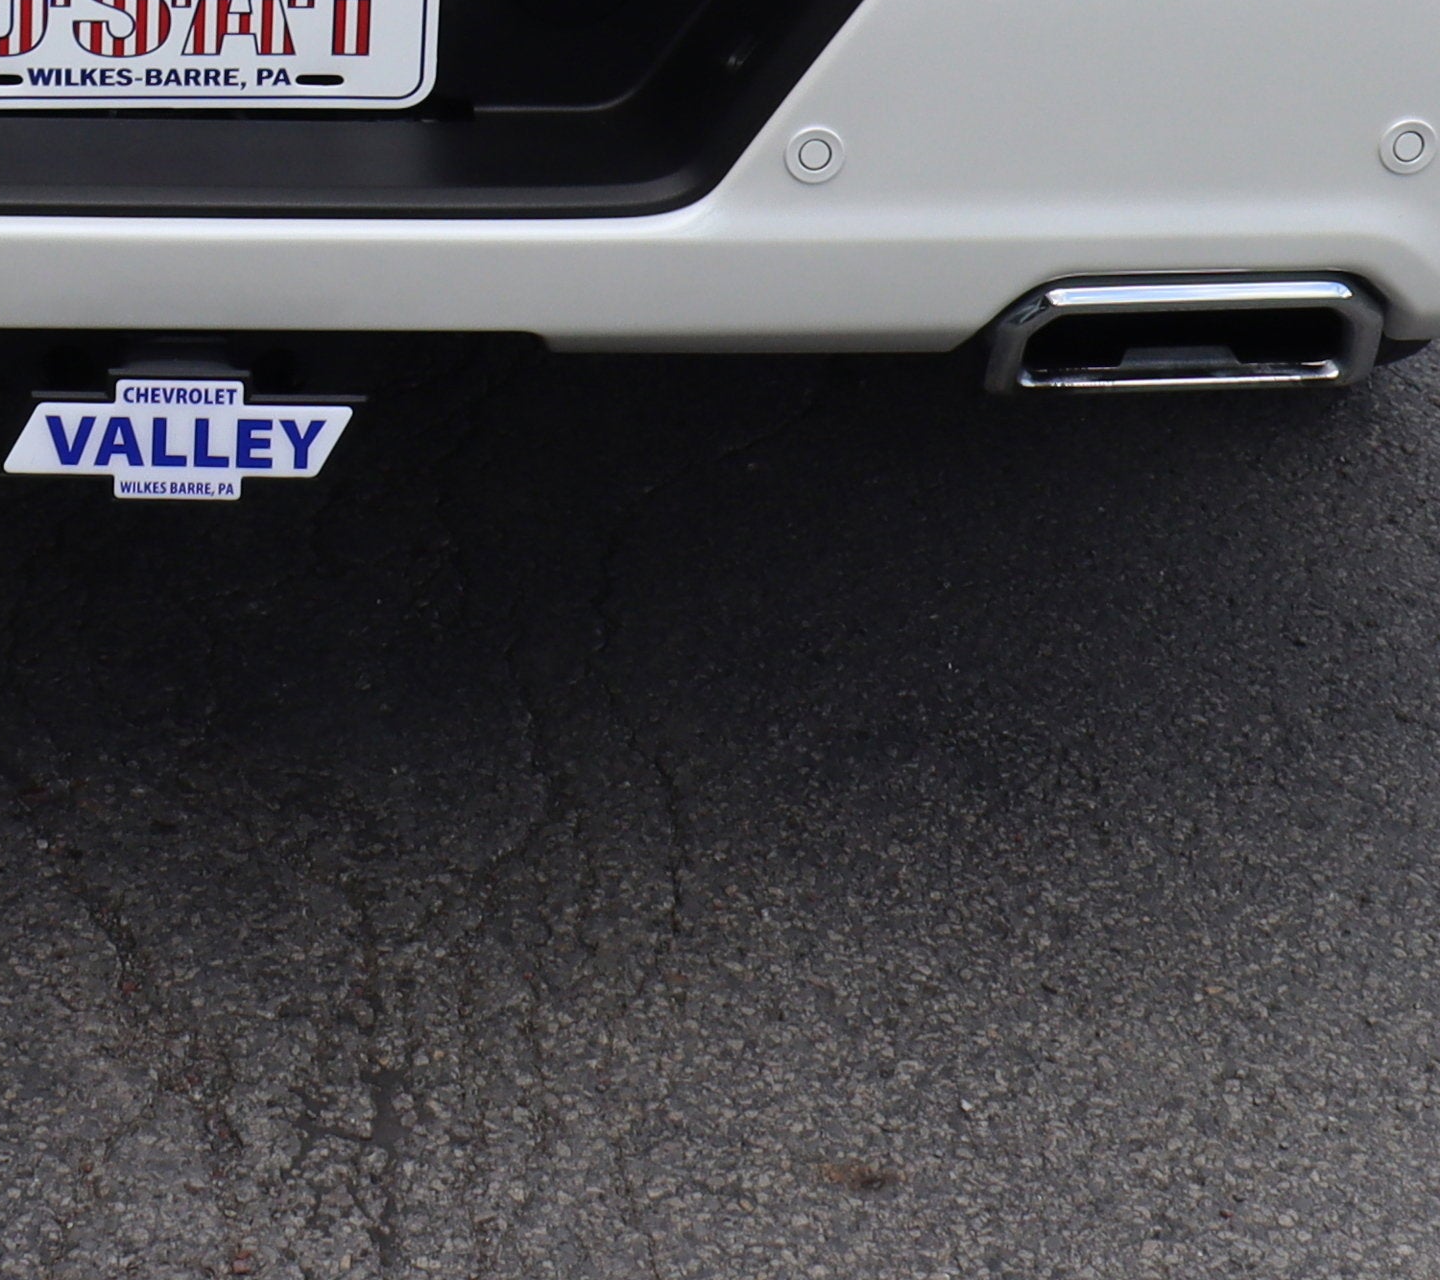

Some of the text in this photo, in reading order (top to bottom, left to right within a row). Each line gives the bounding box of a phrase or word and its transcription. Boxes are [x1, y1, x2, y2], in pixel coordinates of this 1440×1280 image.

[27, 68, 292, 91] WILKES-BARRE, PA
[122, 386, 238, 406] CHEVROLET
[44, 414, 327, 470] VALLEY
[119, 480, 235, 497] WILKES BARRE, PA
